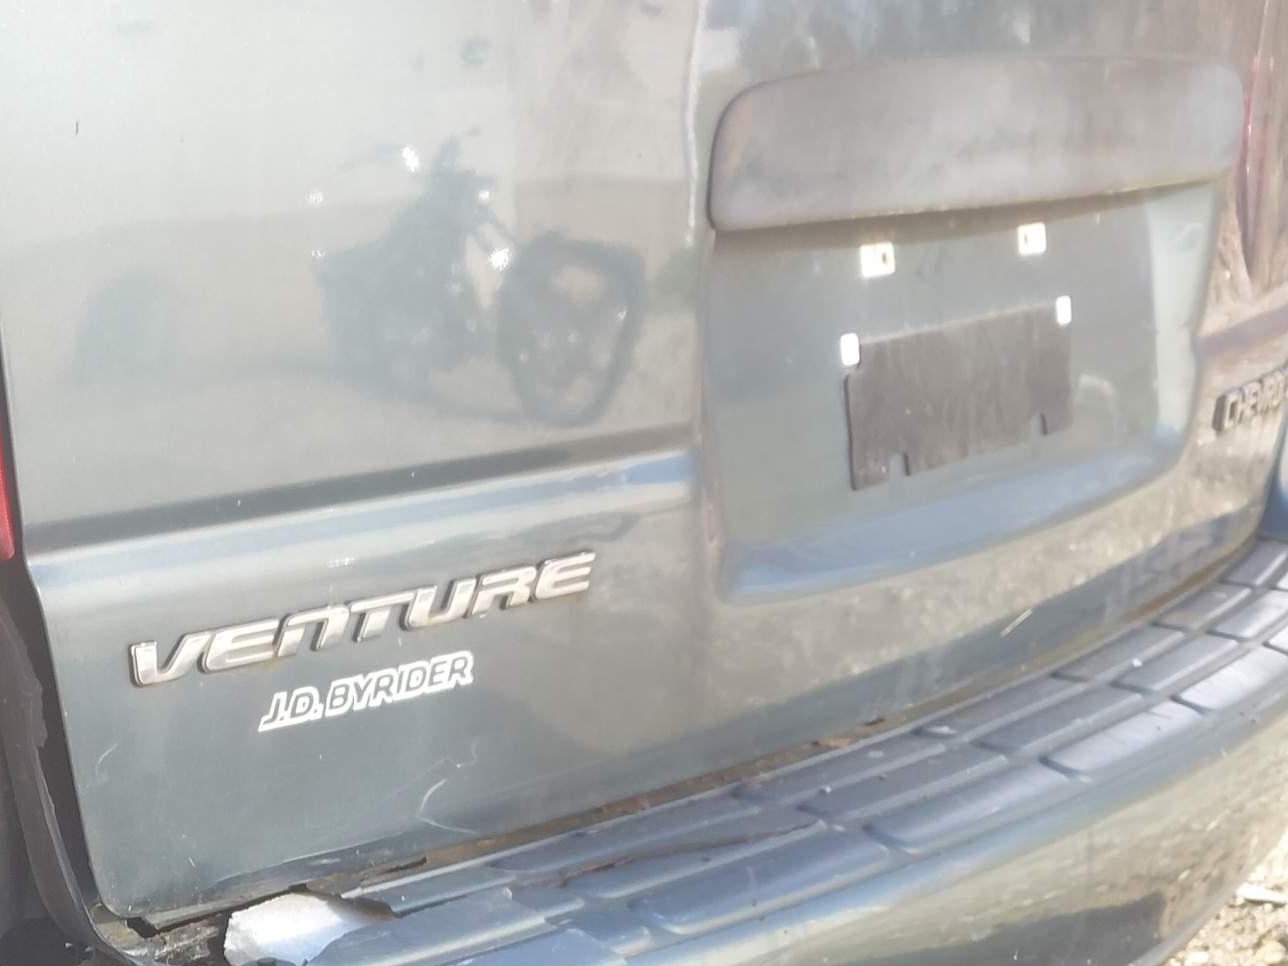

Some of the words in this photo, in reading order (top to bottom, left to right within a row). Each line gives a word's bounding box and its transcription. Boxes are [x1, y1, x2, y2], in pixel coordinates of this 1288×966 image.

[129, 551, 596, 688] VENTURE
[259, 687, 323, 731] J.D.
[325, 651, 473, 717] BYRIDER
